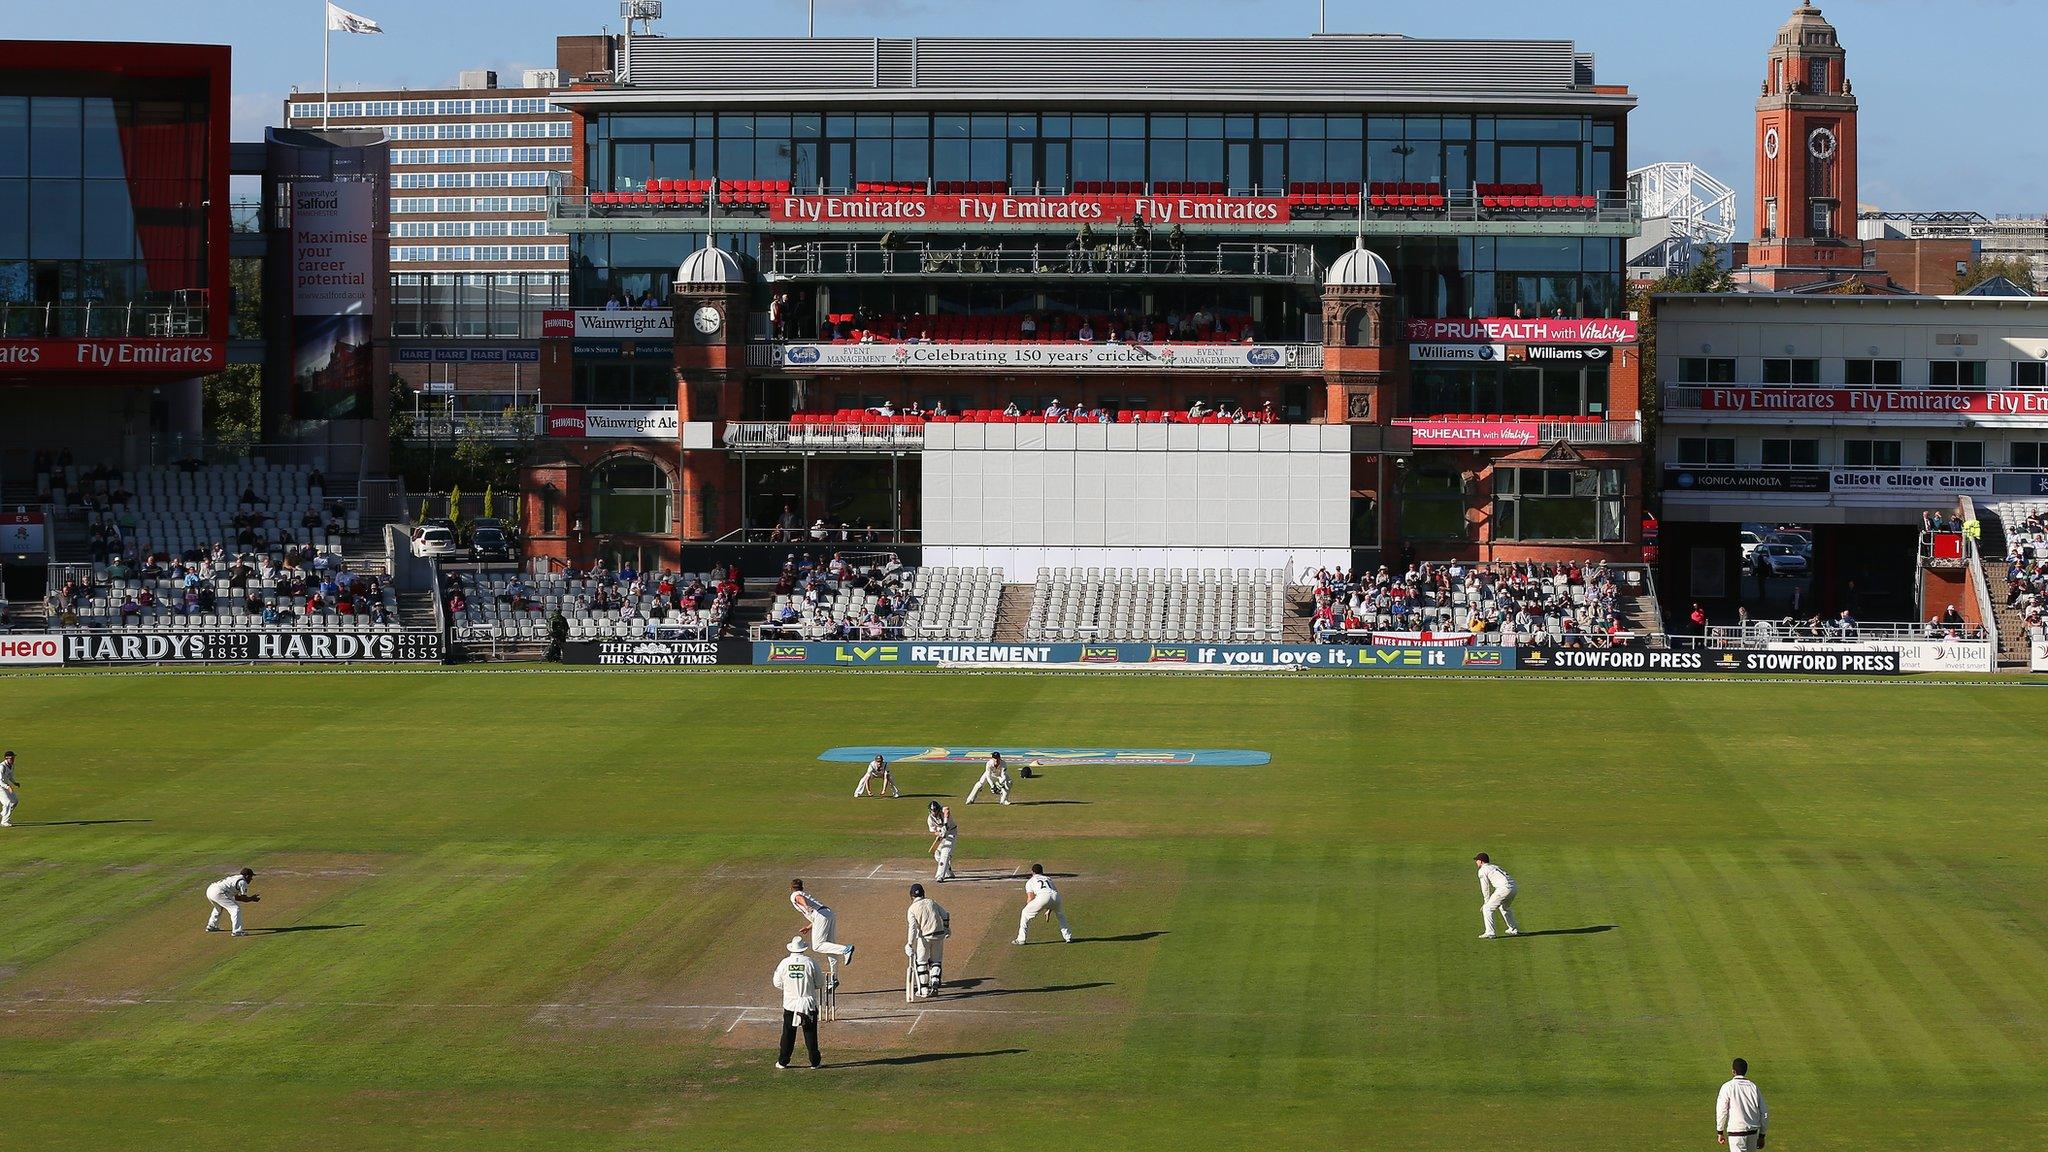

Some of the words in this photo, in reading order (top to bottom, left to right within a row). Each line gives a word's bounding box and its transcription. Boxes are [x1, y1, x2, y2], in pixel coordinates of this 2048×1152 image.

[297, 198, 338, 209] Salford
[784, 198, 821, 221] Fly
[826, 197, 926, 218] Emirates
[959, 198, 997, 221] Fly
[1002, 197, 1101, 218] Emirates
[1135, 199, 1173, 222] Fly
[1178, 198, 1278, 219] Emirates
[298, 231, 368, 243] Maximise
[298, 248, 332, 260] your
[298, 261, 345, 271] career
[298, 273, 365, 287] potential
[580, 316, 656, 333] Wainwright
[658, 317, 675, 328] Al
[1434, 323, 1547, 338] PRUHEALTH
[1551, 325, 1576, 339] with
[1579, 322, 1634, 342] Vitality
[77, 343, 114, 366] Fly
[118, 343, 213, 363] Emirates
[402, 351, 429, 359] HARE
[437, 351, 465, 359] HARE
[473, 351, 501, 359] HARE
[508, 351, 537, 359] HARE
[843, 347, 870, 355] EVENT
[914, 349, 1006, 363] Celebrating
[1014, 349, 1041, 362] 150
[1097, 349, 1150, 362] cricket
[1418, 346, 1474, 358] Williams
[1529, 346, 1582, 359] Williams
[827, 355, 887, 363] MANAGEMENT
[1180, 356, 1240, 364] MANAGEMENT
[1713, 390, 1745, 410] Fly
[1751, 390, 1834, 408] Emirates
[1850, 391, 1882, 412] Fly
[1887, 392, 1971, 410] Emirates
[1986, 393, 2018, 414] Fly
[587, 416, 655, 432] Wainwright
[658, 417, 677, 428] Ale
[1413, 429, 1480, 438] PRUHEALTH
[1483, 430, 1498, 439] with
[1501, 428, 1535, 445] Vitality
[1698, 476, 1736, 485] KONICA
[1739, 476, 1781, 486] MINOLTA
[208, 634, 248, 645] ESTD
[398, 635, 438, 645] ESTD
[1374, 637, 1396, 646] HAYES
[68, 635, 205, 660] HARDYS
[258, 634, 394, 659] HARDYS
[599, 643, 631, 653] THE
[671, 642, 718, 653] TIMES
[209, 648, 248, 659] 1853
[398, 648, 438, 659] 1853
[599, 655, 628, 664] THE
[626, 655, 677, 664] SUNDAY
[678, 655, 717, 664] TIMES
[911, 646, 1051, 662] RETIREMENT
[1198, 648, 1216, 663] If
[1222, 652, 1264, 665] you
[1273, 649, 1321, 664] love
[1329, 649, 1352, 666] it,
[1428, 650, 1445, 664] it
[1555, 651, 1645, 667] STOWFORD
[1650, 653, 1701, 668] PRESS
[1747, 653, 1838, 670] STOWFORD
[1842, 655, 1894, 671] PRESS
